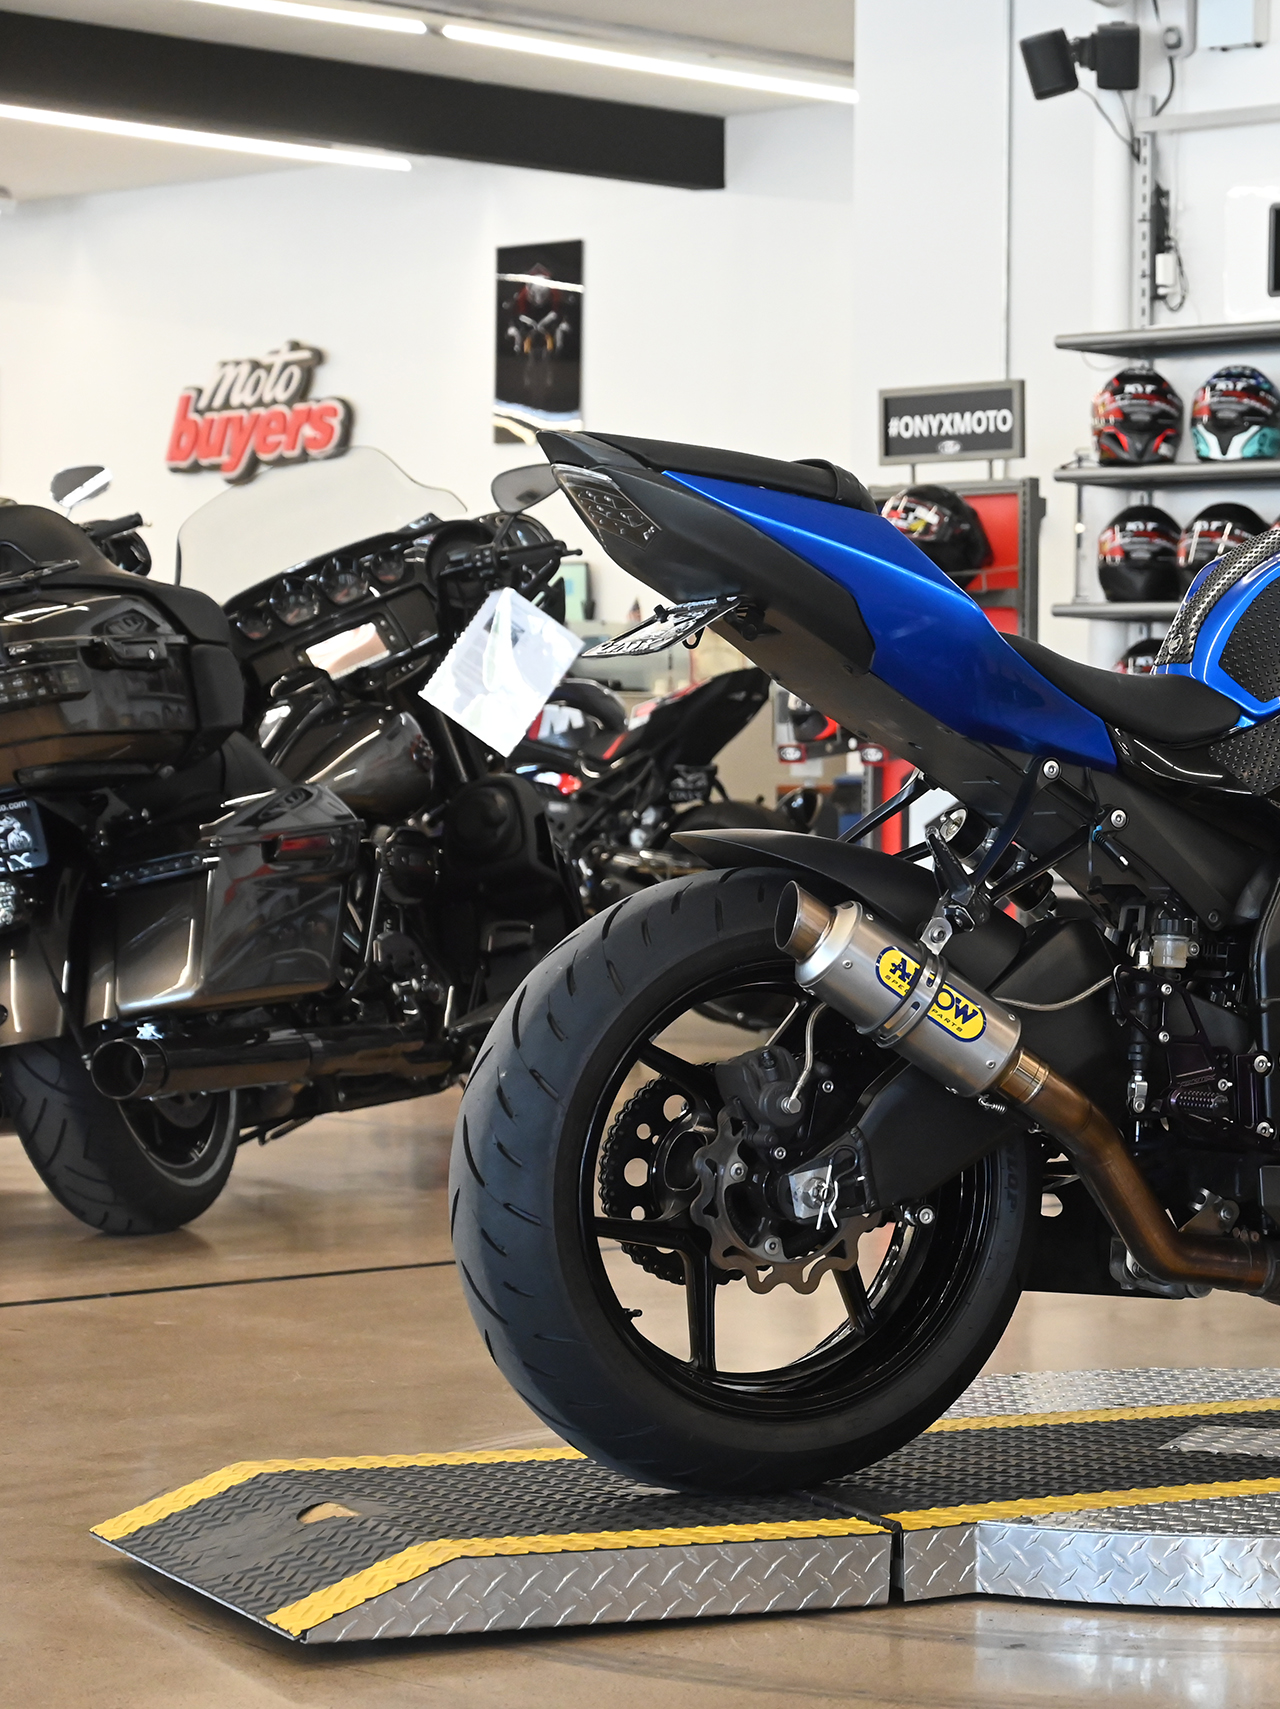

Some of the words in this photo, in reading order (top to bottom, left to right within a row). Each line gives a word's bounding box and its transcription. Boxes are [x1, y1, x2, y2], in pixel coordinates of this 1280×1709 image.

[166, 391, 343, 478] buyers
[887, 408, 1014, 439] #ONYXMOTO
[888, 957, 979, 1025] AOW
[931, 1008, 964, 1033] PARTS
